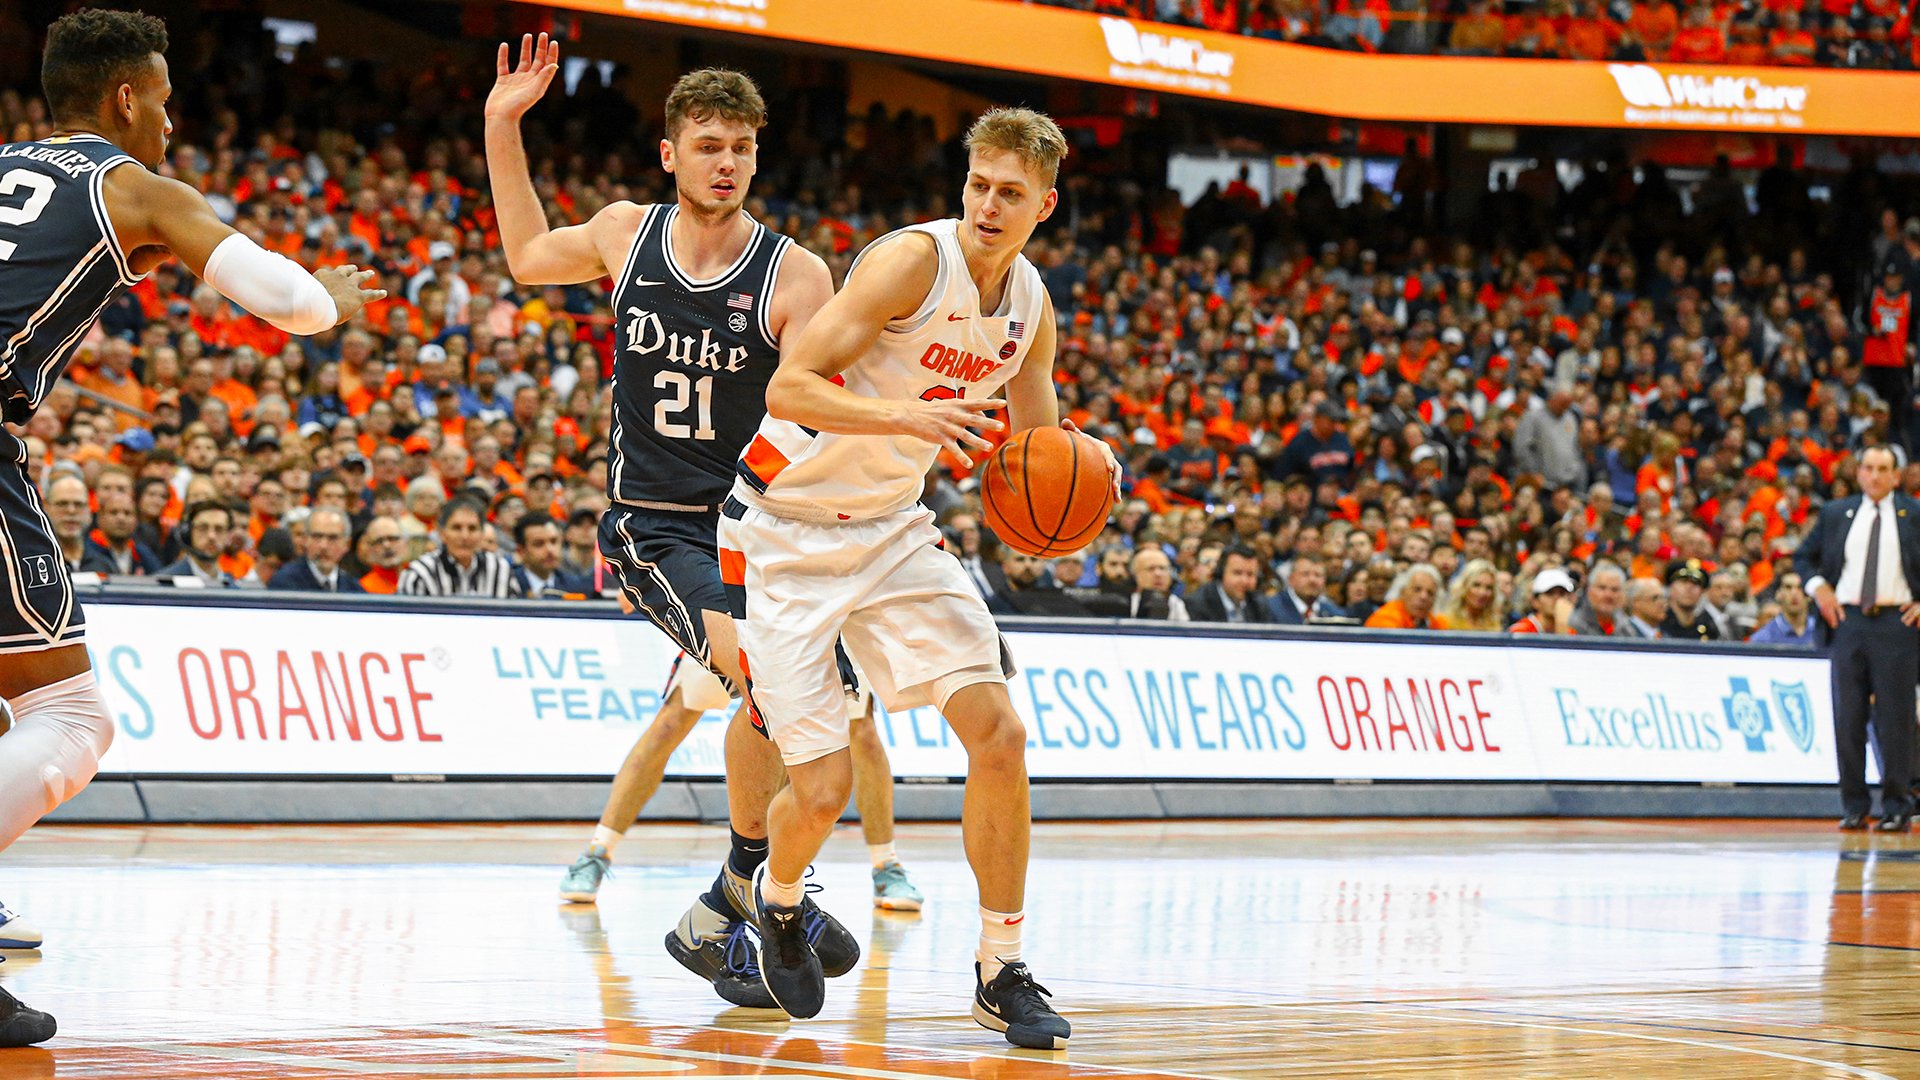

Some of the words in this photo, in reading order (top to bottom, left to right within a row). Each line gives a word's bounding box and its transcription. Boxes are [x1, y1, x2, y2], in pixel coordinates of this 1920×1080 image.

[1668, 74, 1809, 111] WellCare
[626, 306, 748, 373] Duke
[920, 342, 1005, 383] ORANG
[653, 370, 716, 440] 21
[177, 646, 444, 743] ORANGE
[492, 646, 606, 681] LIVE
[1126, 669, 1307, 751] WEARS
[1317, 675, 1501, 752] ORANGE
[1552, 686, 1724, 753] Excellus
